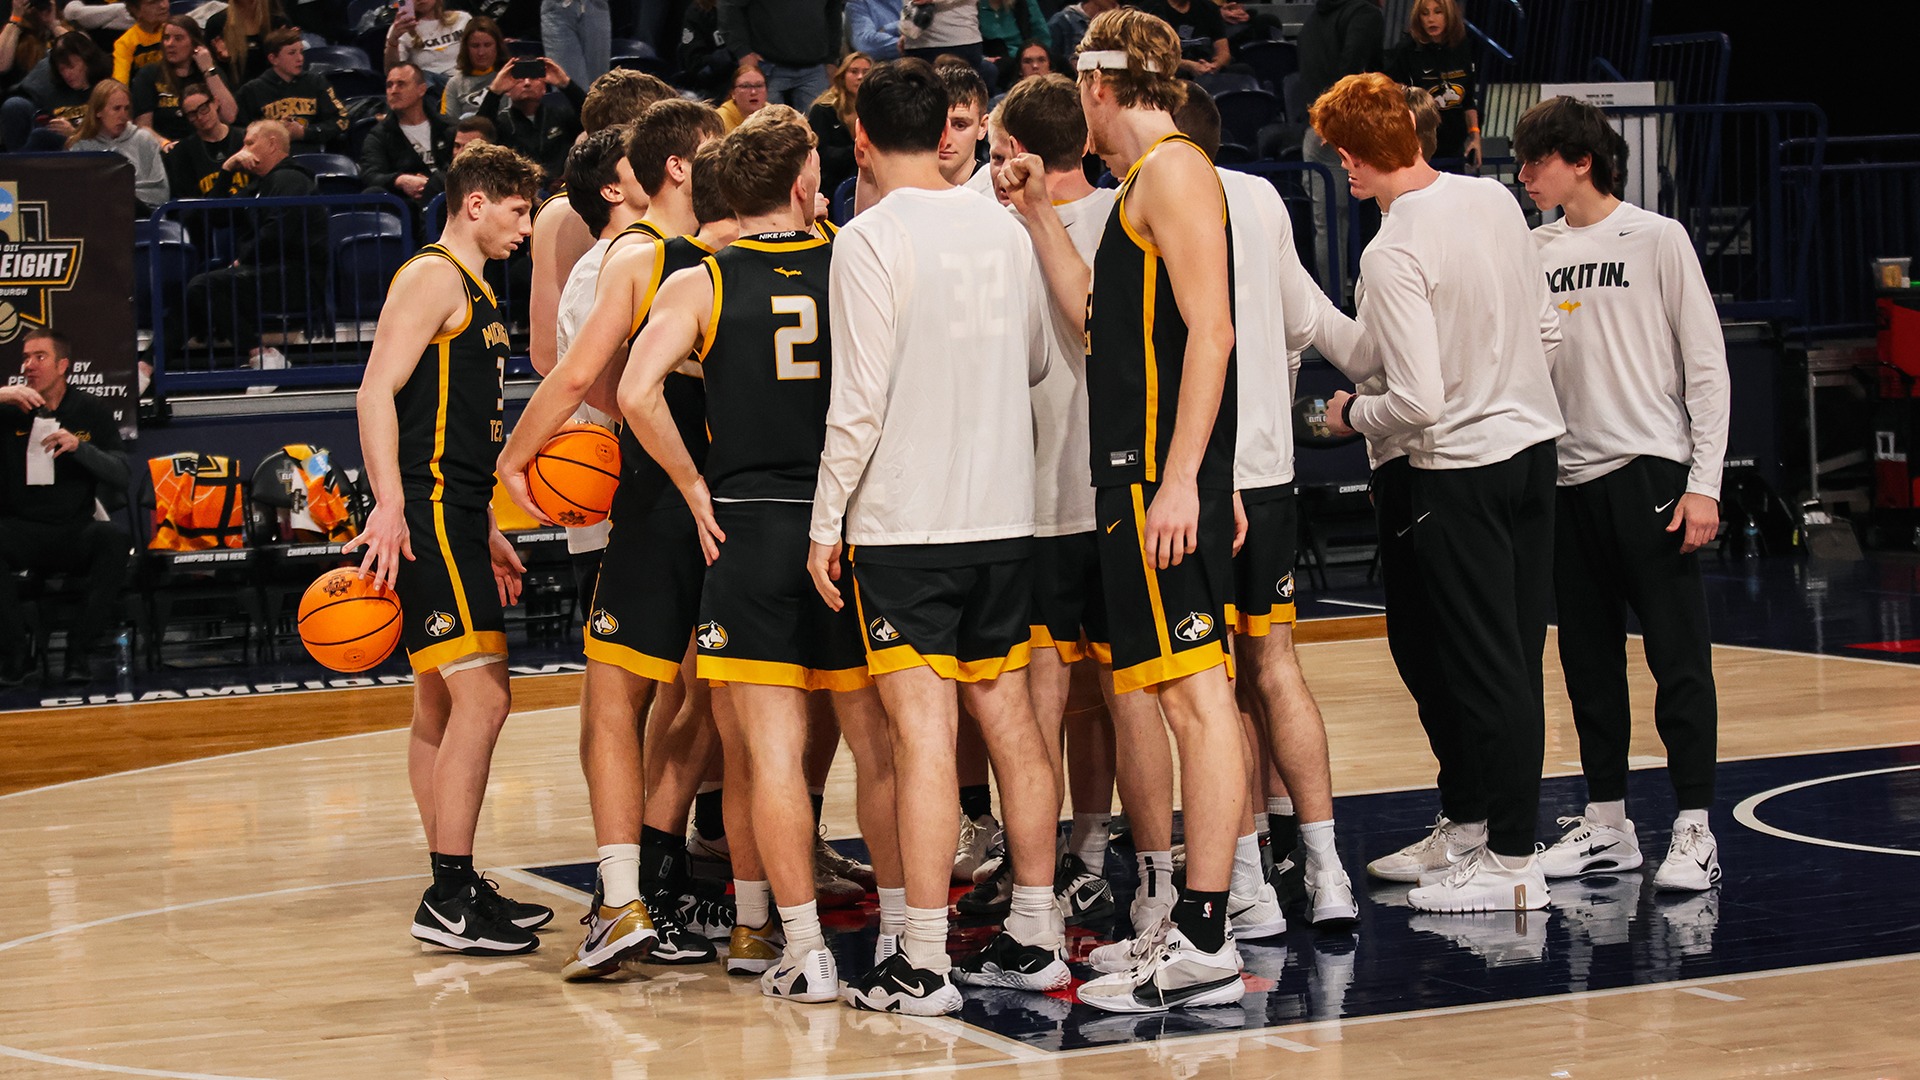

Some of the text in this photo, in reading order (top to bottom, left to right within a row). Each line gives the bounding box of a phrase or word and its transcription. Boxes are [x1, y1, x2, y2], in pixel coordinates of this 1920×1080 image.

[759, 232, 779, 240] NIKE
[0, 253, 67, 278] EIGHT
[1577, 263, 1598, 289] IT
[1598, 262, 1630, 288] IN.
[770, 295, 821, 380] 2
[73, 362, 91, 373] BY
[174, 552, 247, 564] CHAMPIONS WIN HERE
[287, 546, 326, 557] CHAMPIONS
[40, 674, 414, 708] CHAMPION
